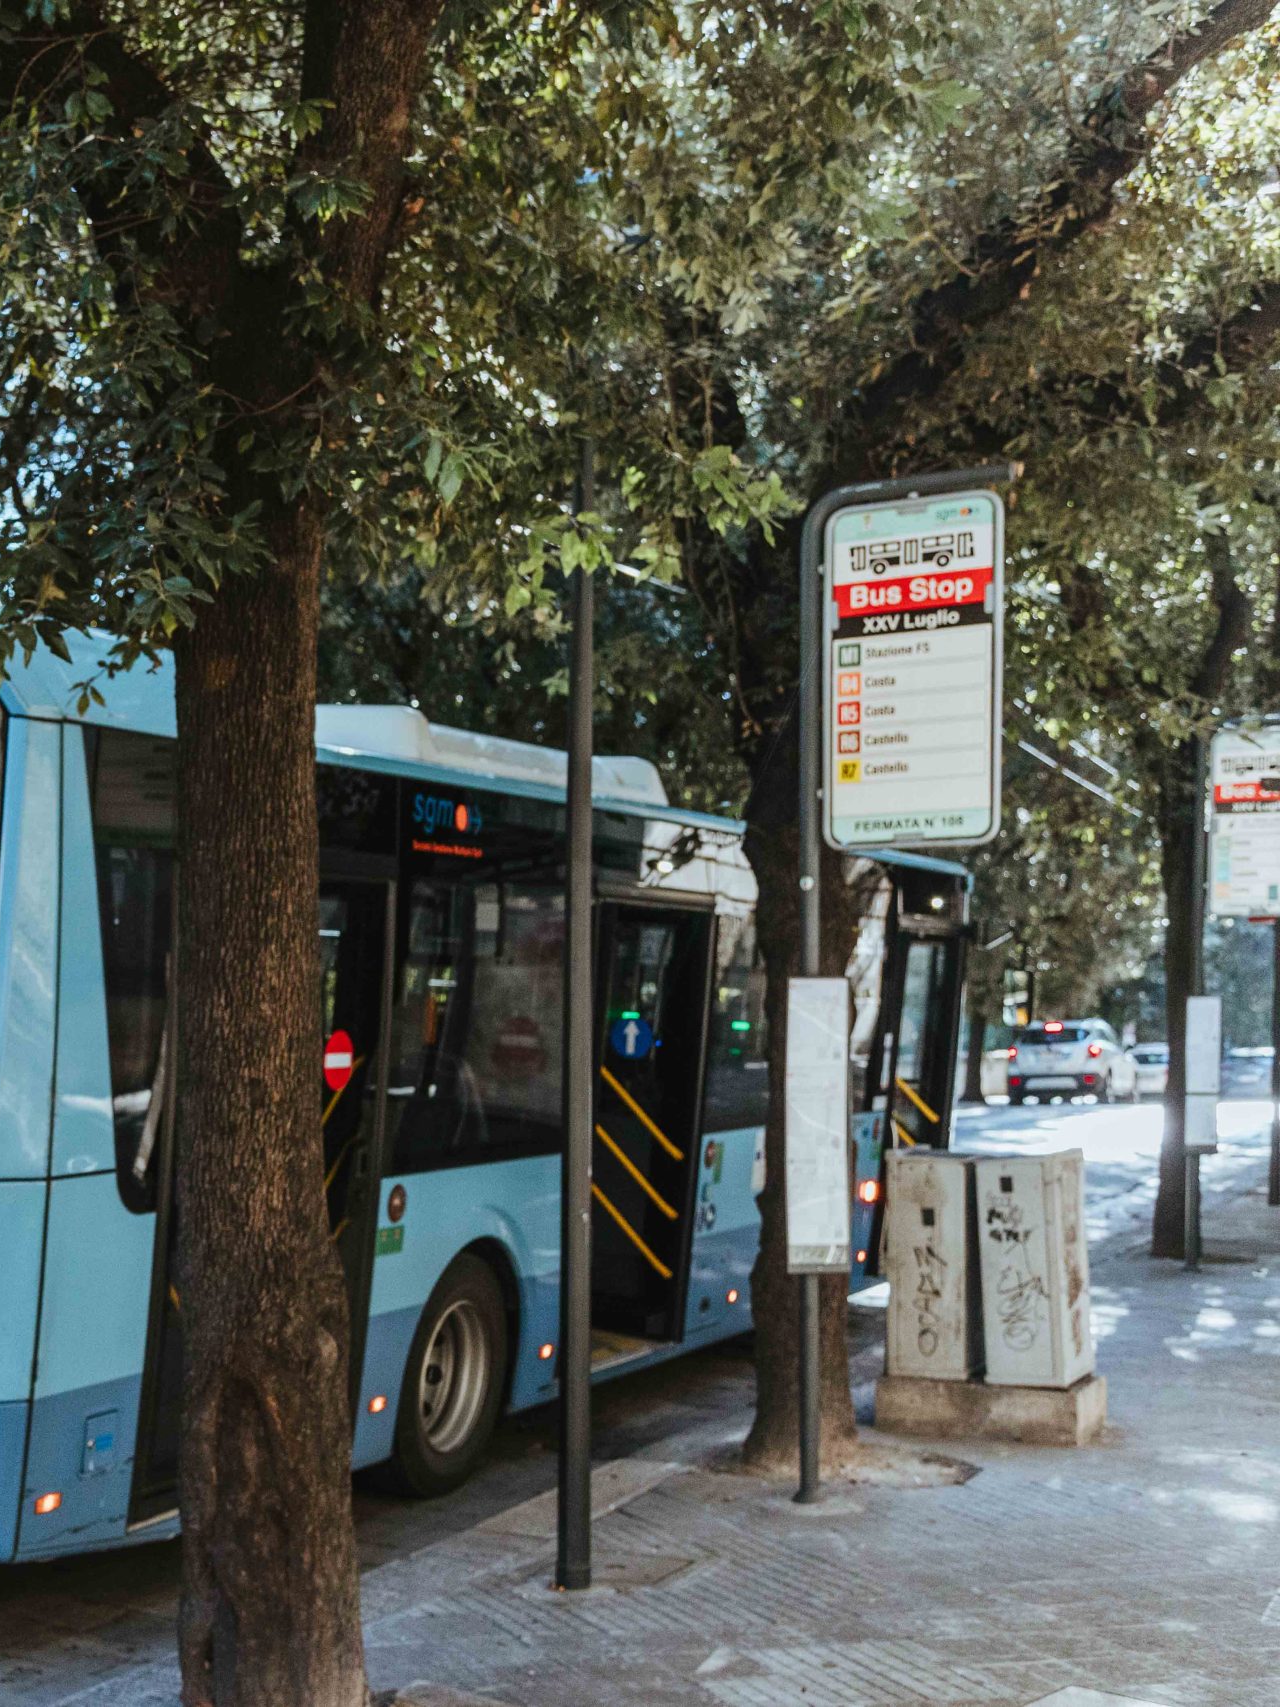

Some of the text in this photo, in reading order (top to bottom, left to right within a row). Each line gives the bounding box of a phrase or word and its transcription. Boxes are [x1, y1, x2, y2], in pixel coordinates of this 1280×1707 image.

[850, 577, 973, 609] Bus Stop
[862, 609, 960, 634] XXV Luglio
[413, 793, 452, 833] sgm
[853, 817, 920, 833] FERMATA
